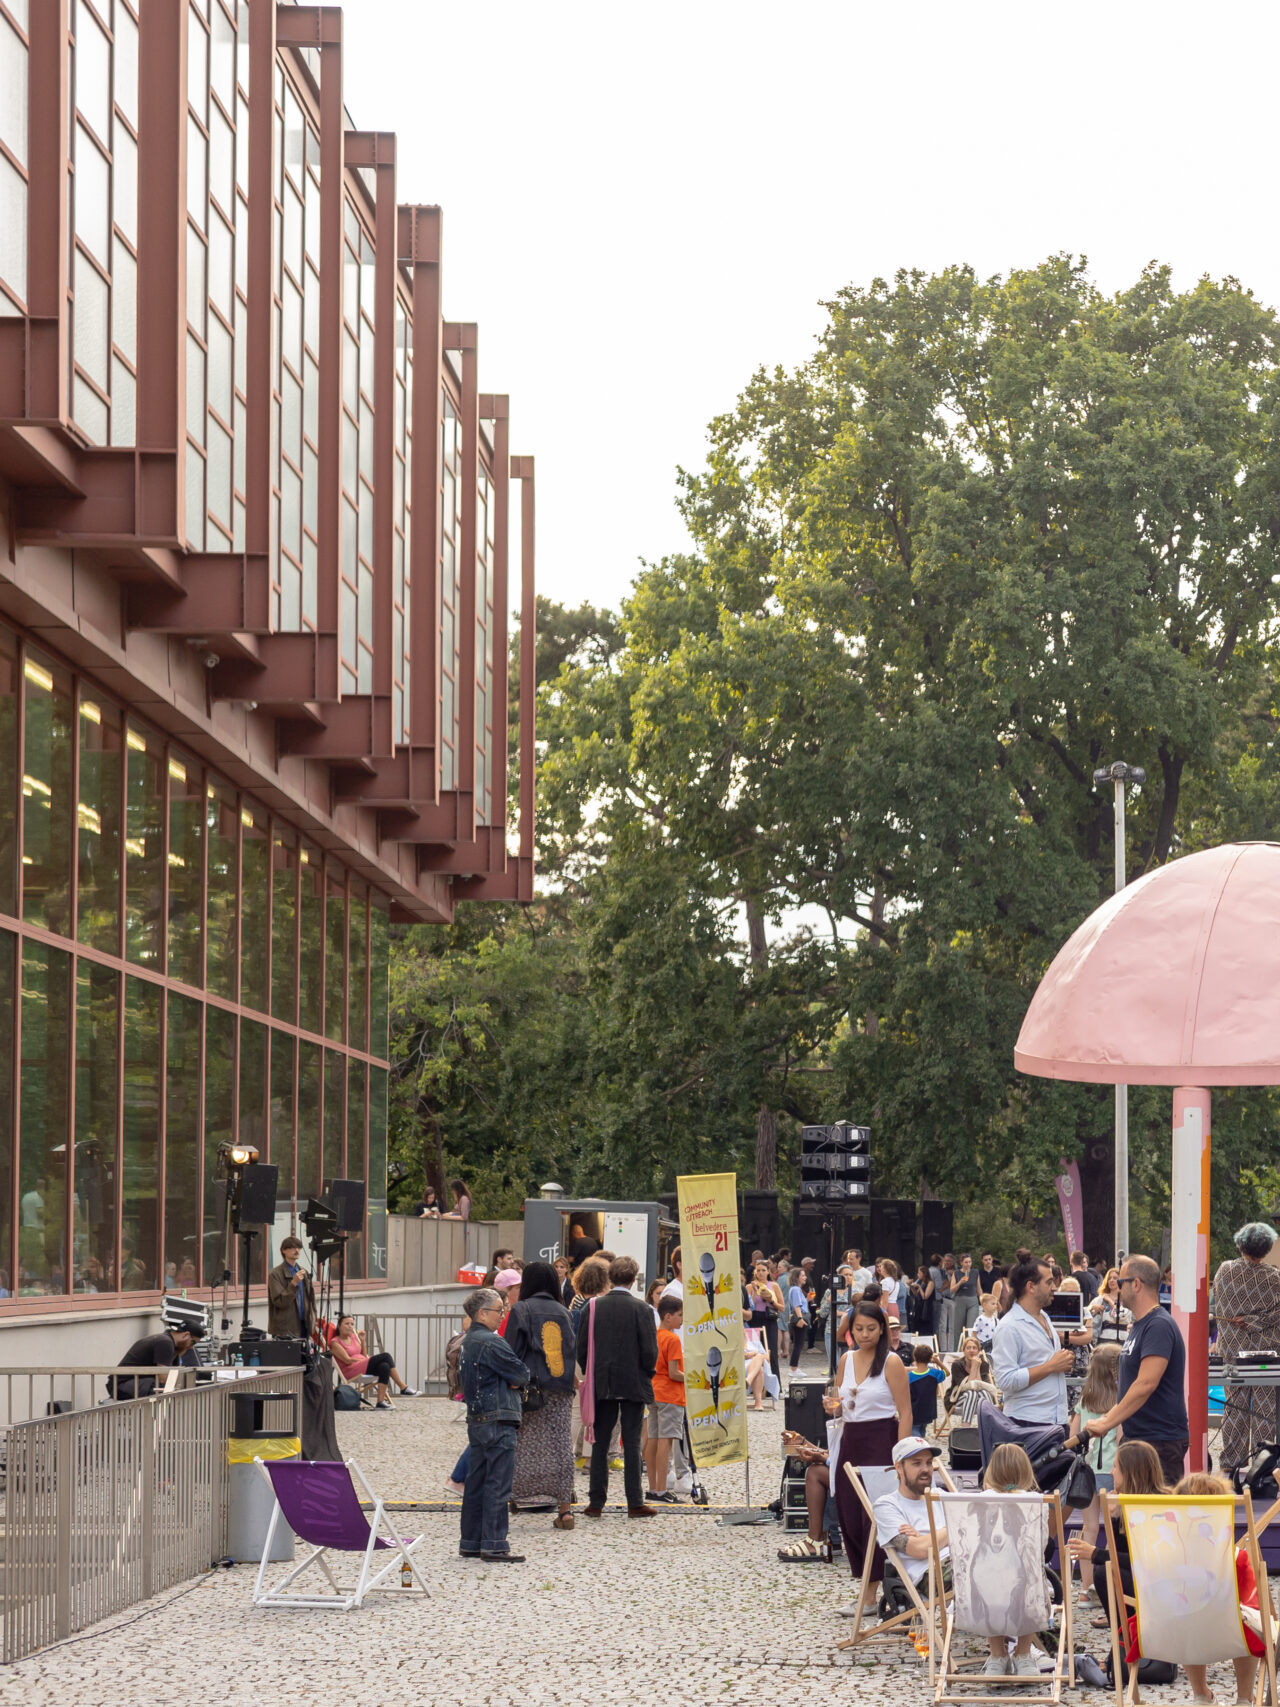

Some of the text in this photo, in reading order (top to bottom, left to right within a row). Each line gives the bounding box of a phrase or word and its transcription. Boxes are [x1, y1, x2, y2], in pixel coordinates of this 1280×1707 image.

[695, 1221, 727, 1232] belvedere
[715, 1231, 728, 1252] 21
[686, 1311, 738, 1336] OPEN MIC
[722, 1405, 742, 1421] MIC
